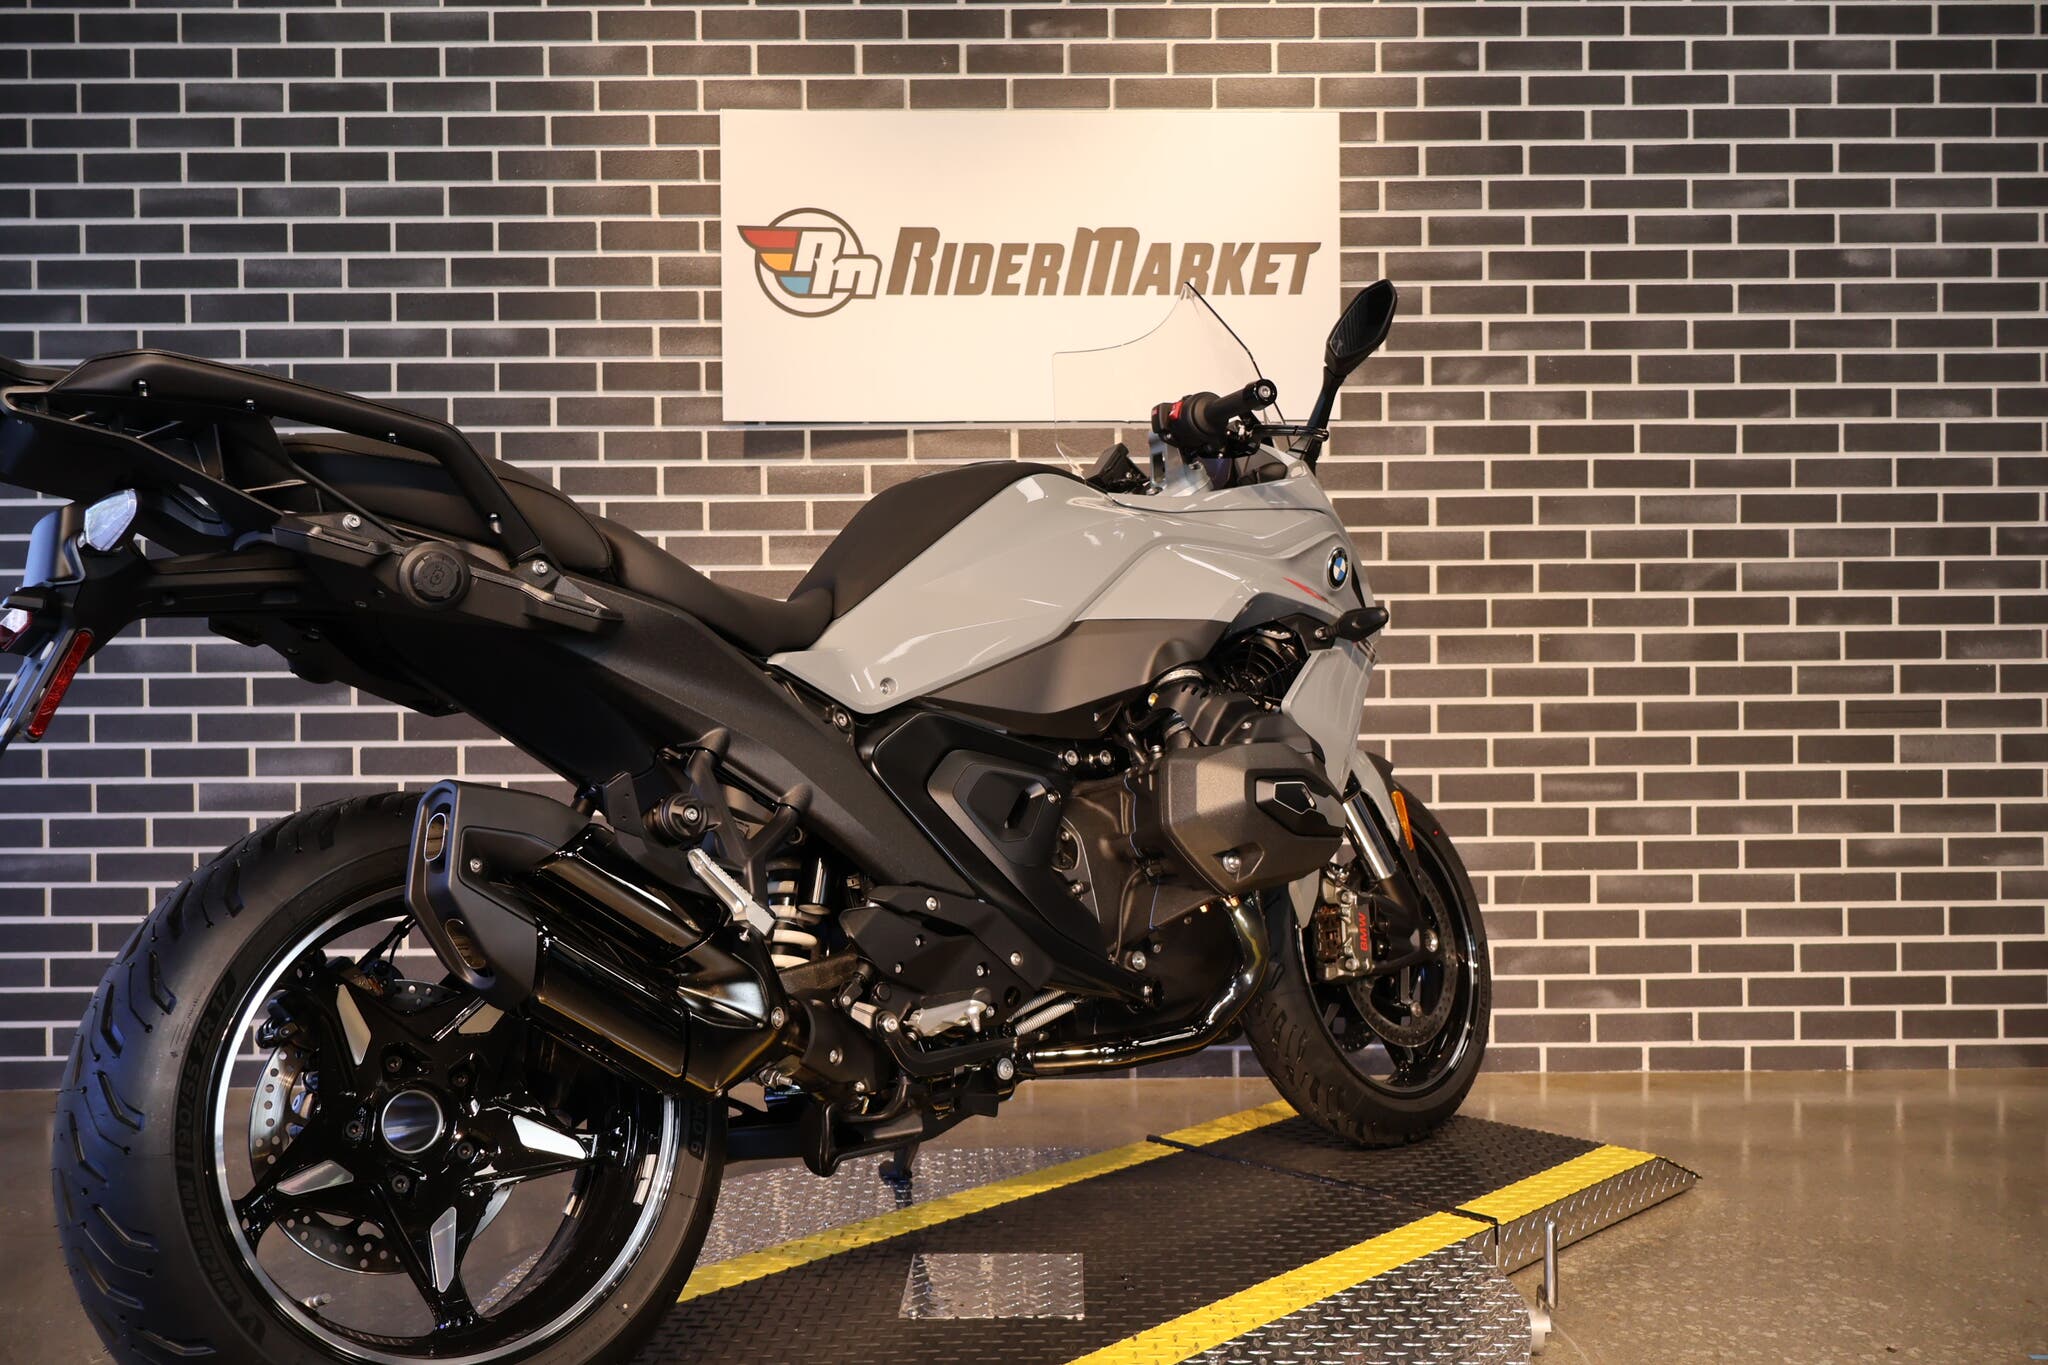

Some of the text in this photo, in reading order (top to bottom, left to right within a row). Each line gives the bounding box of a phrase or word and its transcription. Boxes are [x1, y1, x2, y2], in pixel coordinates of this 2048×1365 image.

[1358, 911, 1369, 953] BMW
[194, 1016, 215, 1056] ZR
[179, 1179, 239, 1303] MICHELIN
